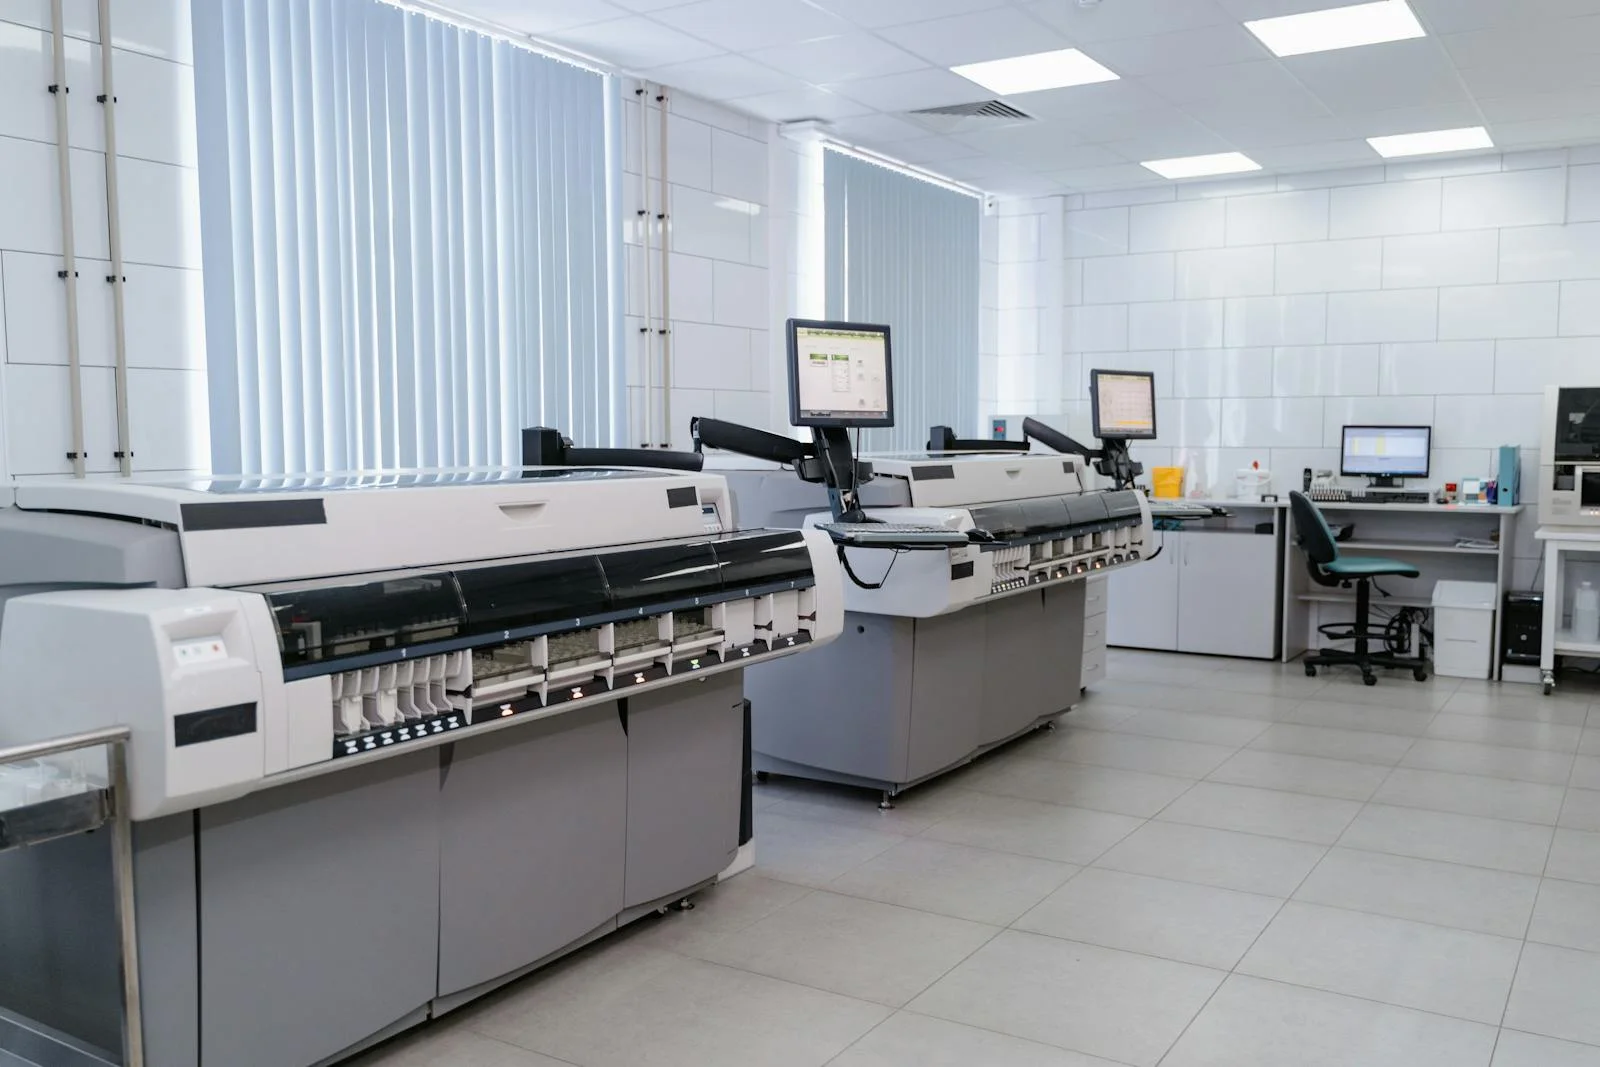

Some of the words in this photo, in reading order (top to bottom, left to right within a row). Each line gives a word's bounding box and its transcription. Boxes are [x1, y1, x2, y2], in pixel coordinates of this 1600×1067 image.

[401, 648, 407, 657] 1
[504, 630, 510, 639] 2
[575, 618, 580, 626] 3
